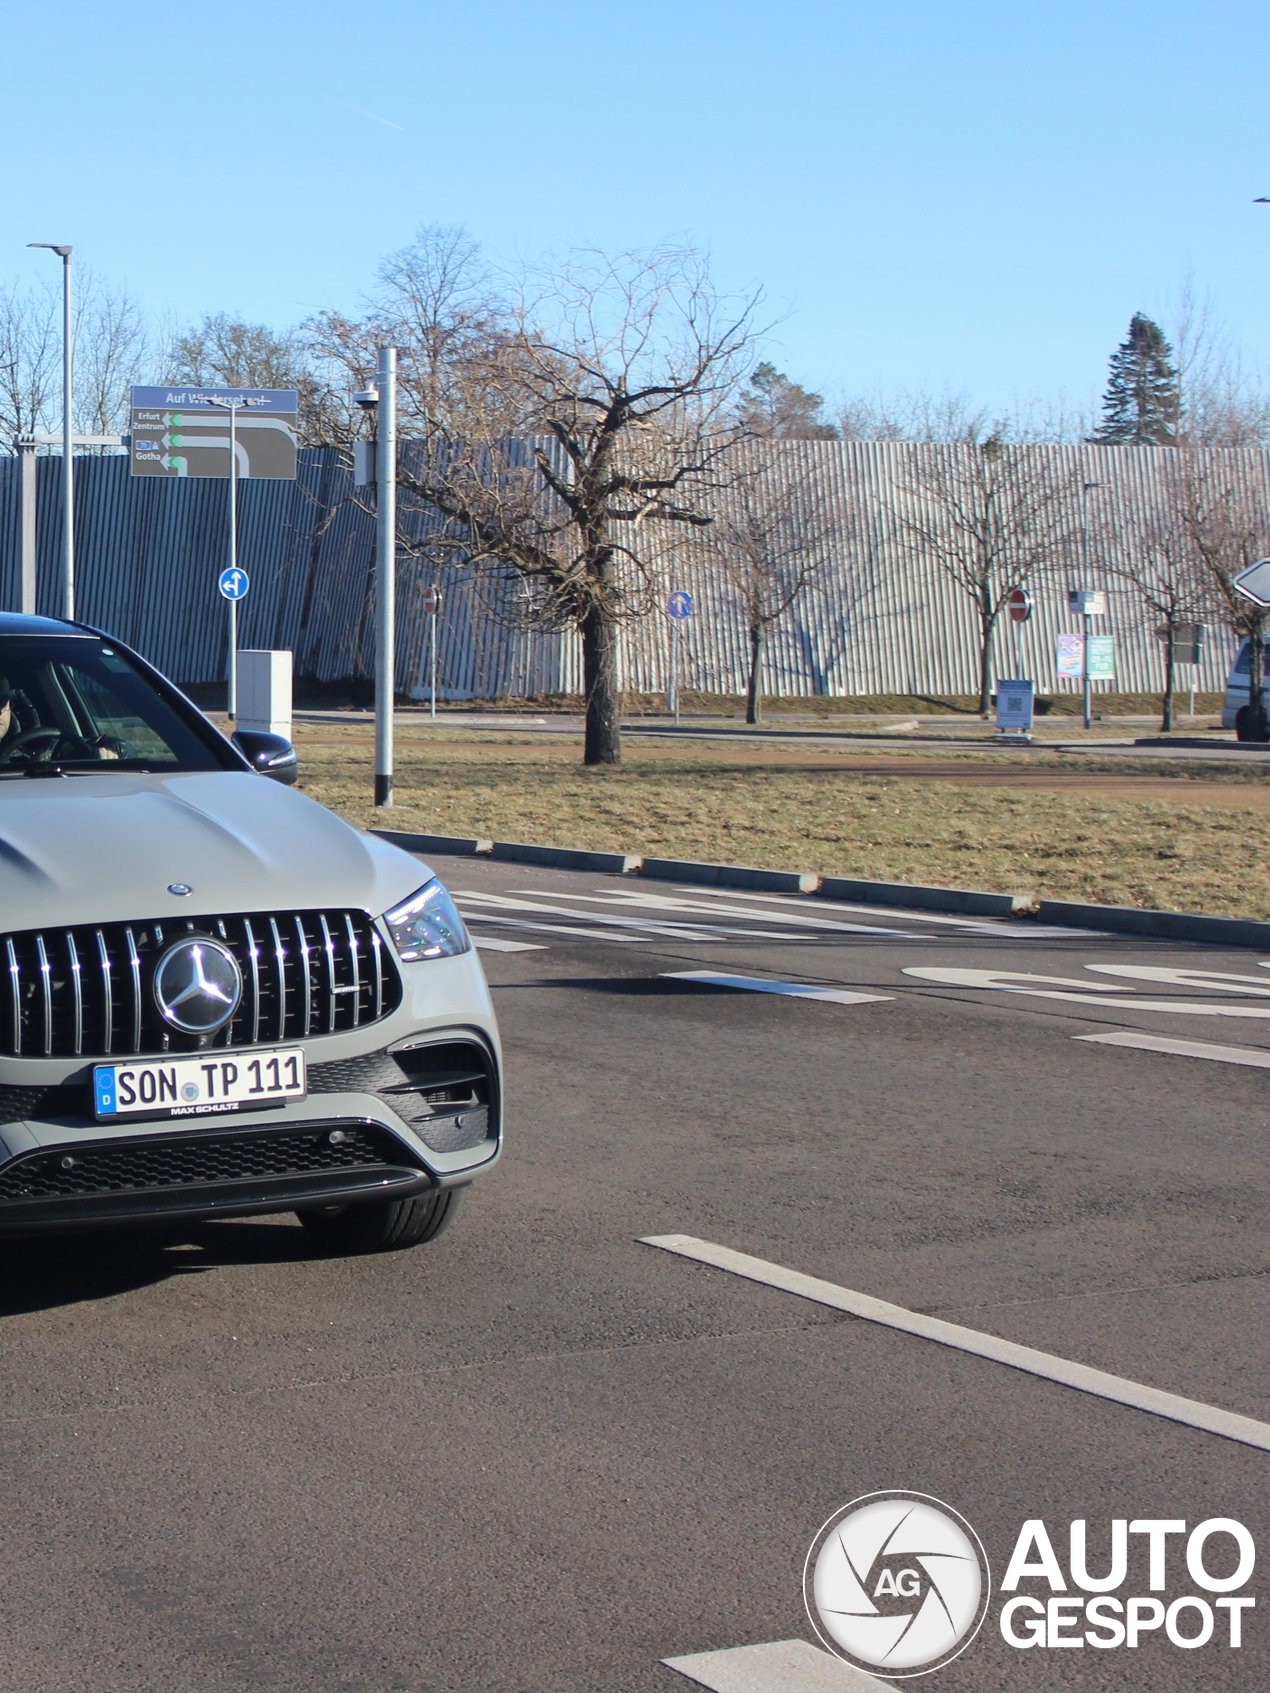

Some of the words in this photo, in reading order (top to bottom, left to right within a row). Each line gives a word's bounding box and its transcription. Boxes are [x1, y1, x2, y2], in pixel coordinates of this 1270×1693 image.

[165, 392, 186, 404] Auf
[188, 393, 264, 406] Wieersehn!
[138, 412, 160, 420] Erfurt
[133, 422, 165, 430] Zentrum
[136, 452, 161, 461] Gotha
[102, 1094, 111, 1106] D
[118, 1067, 178, 1106] SON
[201, 1062, 238, 1098] TP
[247, 1056, 301, 1094] 111
[171, 1105, 195, 1116] MAX
[195, 1102, 240, 1114] SCHULTZ
